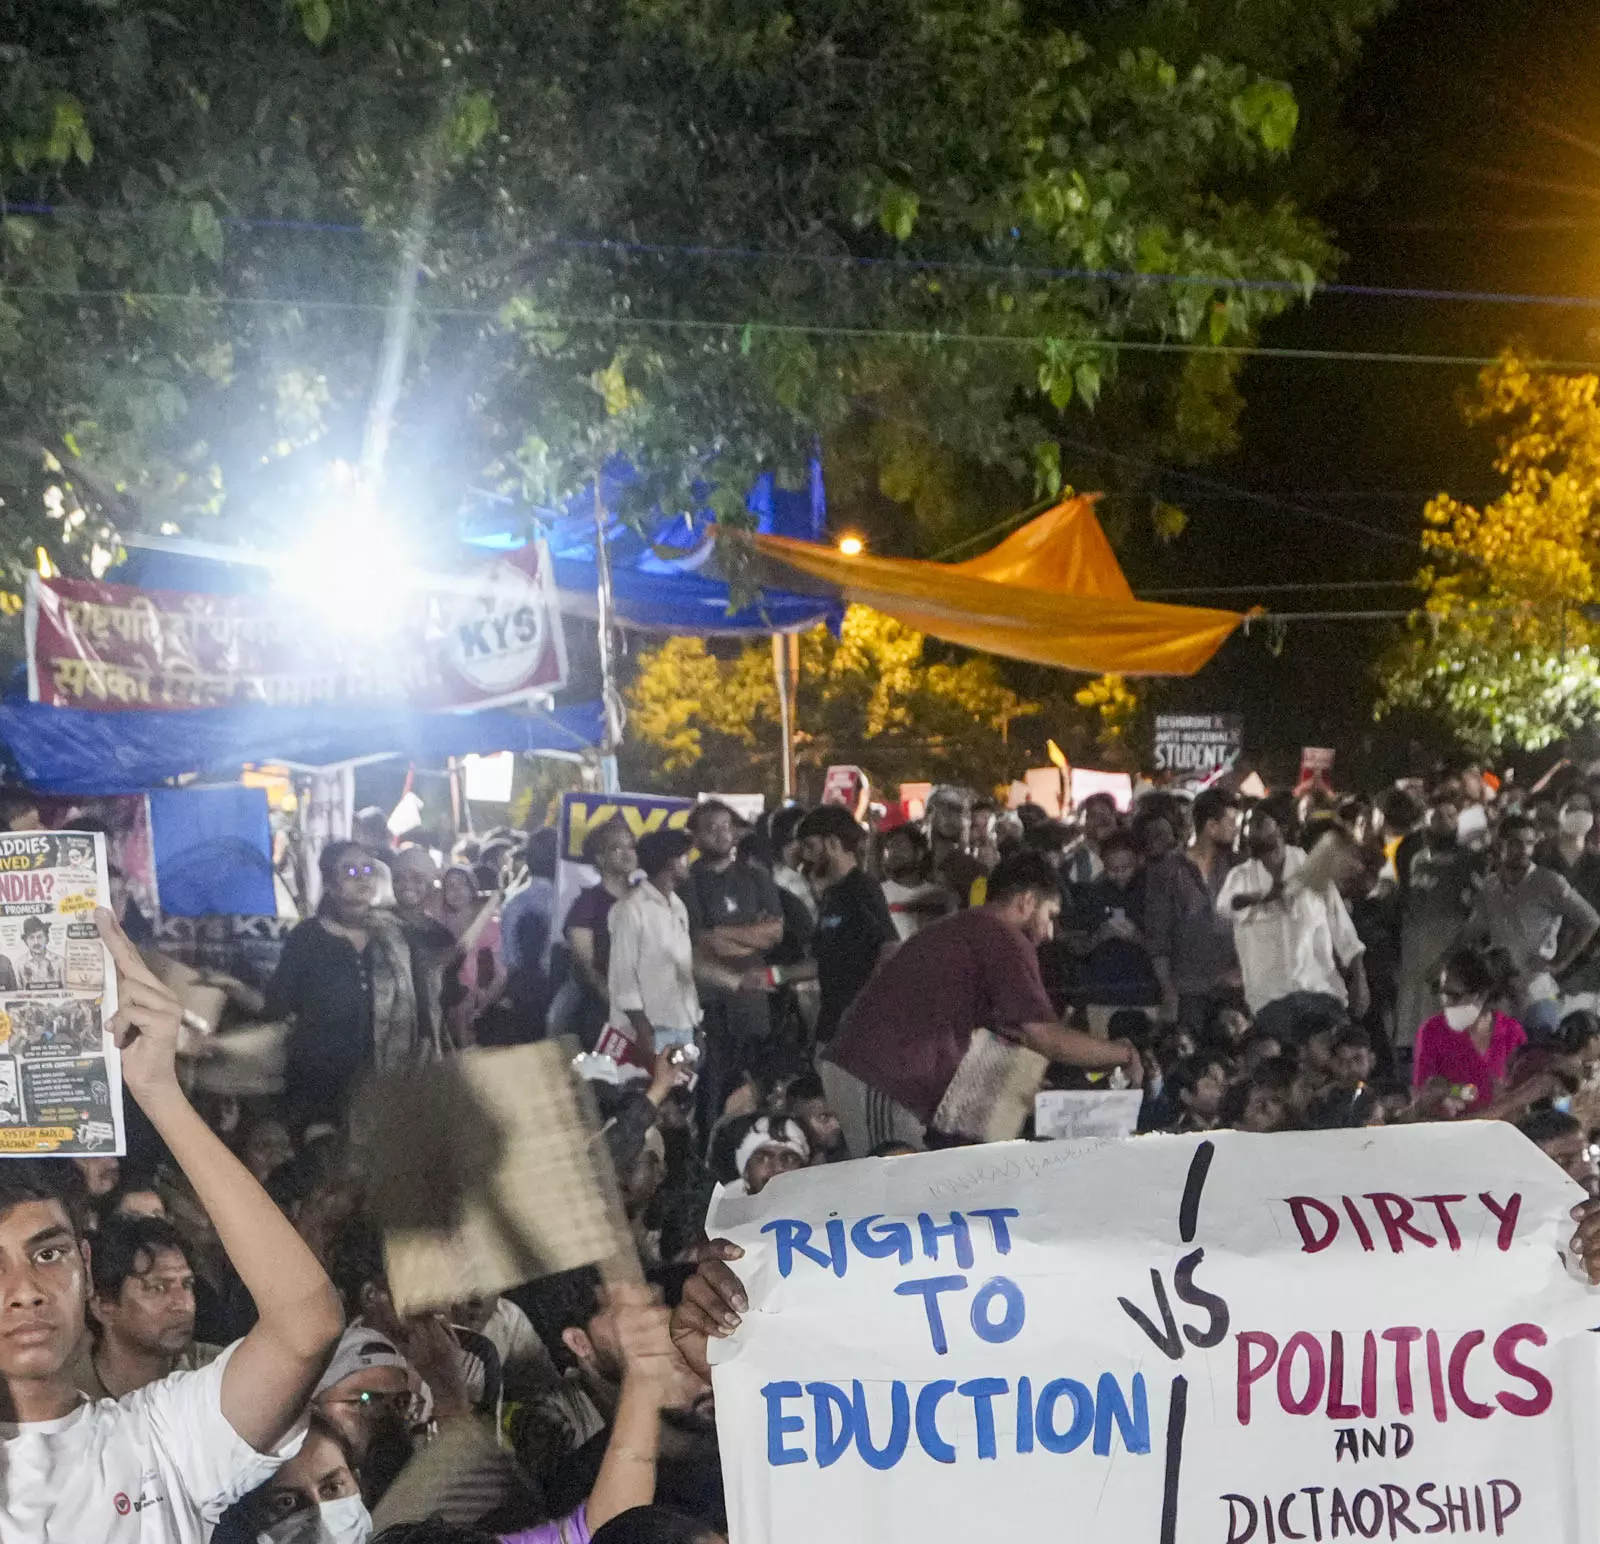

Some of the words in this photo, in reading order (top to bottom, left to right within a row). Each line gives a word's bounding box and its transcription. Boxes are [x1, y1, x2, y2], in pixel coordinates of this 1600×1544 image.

[457, 604, 538, 660] KYS
[1154, 744, 1228, 770] STUDENT
[4, 904, 46, 915] PROMISE?
[1284, 1191, 1523, 1255] DIRTY
[894, 1275, 1027, 1356] TO
[1117, 1247, 1231, 1361] VS
[1234, 1321, 1554, 1425] POLITICS
[760, 1371, 1151, 1471] EDUCTION
[1334, 1423, 1415, 1463] AND
